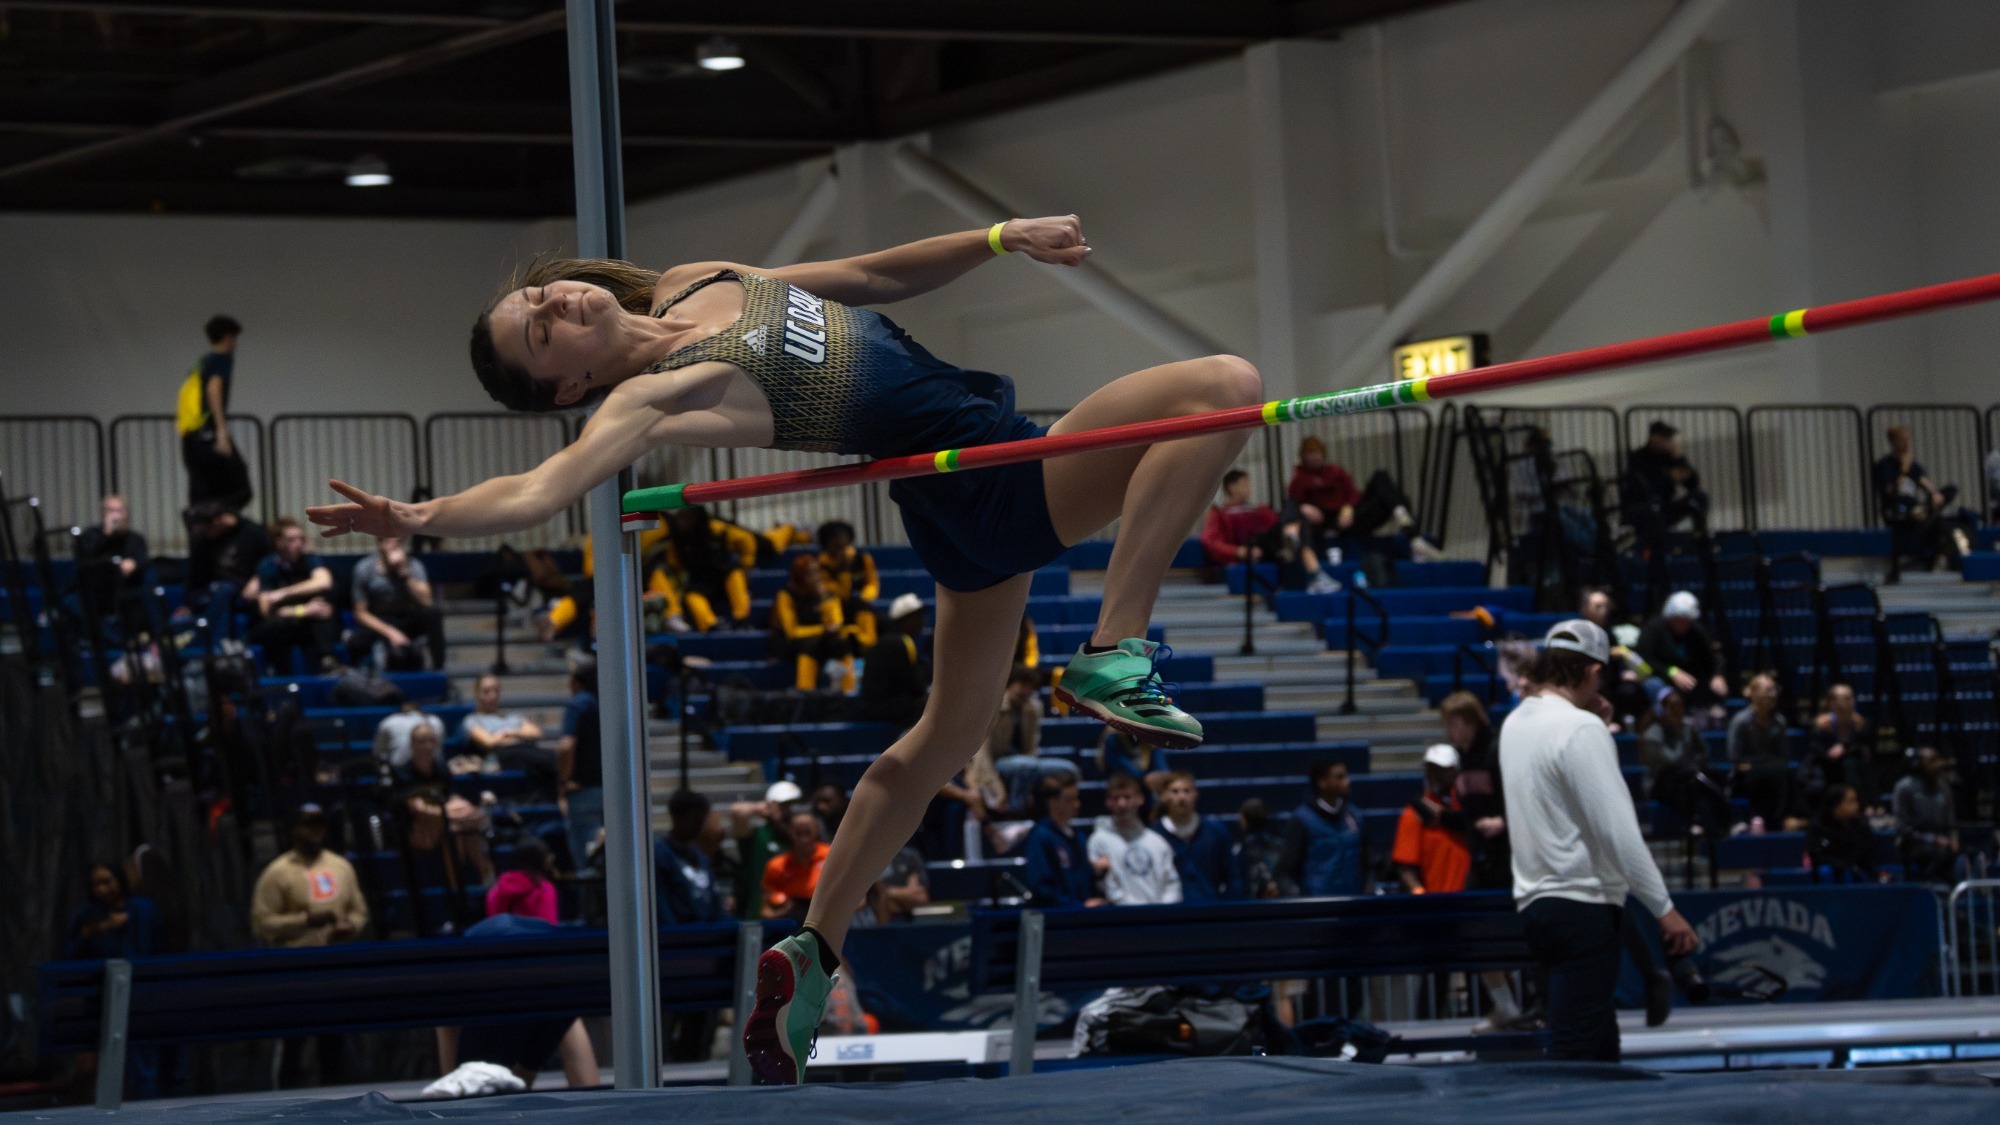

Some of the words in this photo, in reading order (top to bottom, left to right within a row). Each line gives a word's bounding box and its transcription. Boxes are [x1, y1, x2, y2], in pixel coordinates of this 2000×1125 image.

[786, 283, 826, 327] DAV
[757, 324, 768, 357] adidas
[784, 319, 826, 364] UC
[1401, 346, 1466, 380] EXIT
[1696, 897, 1837, 955] NEVADA
